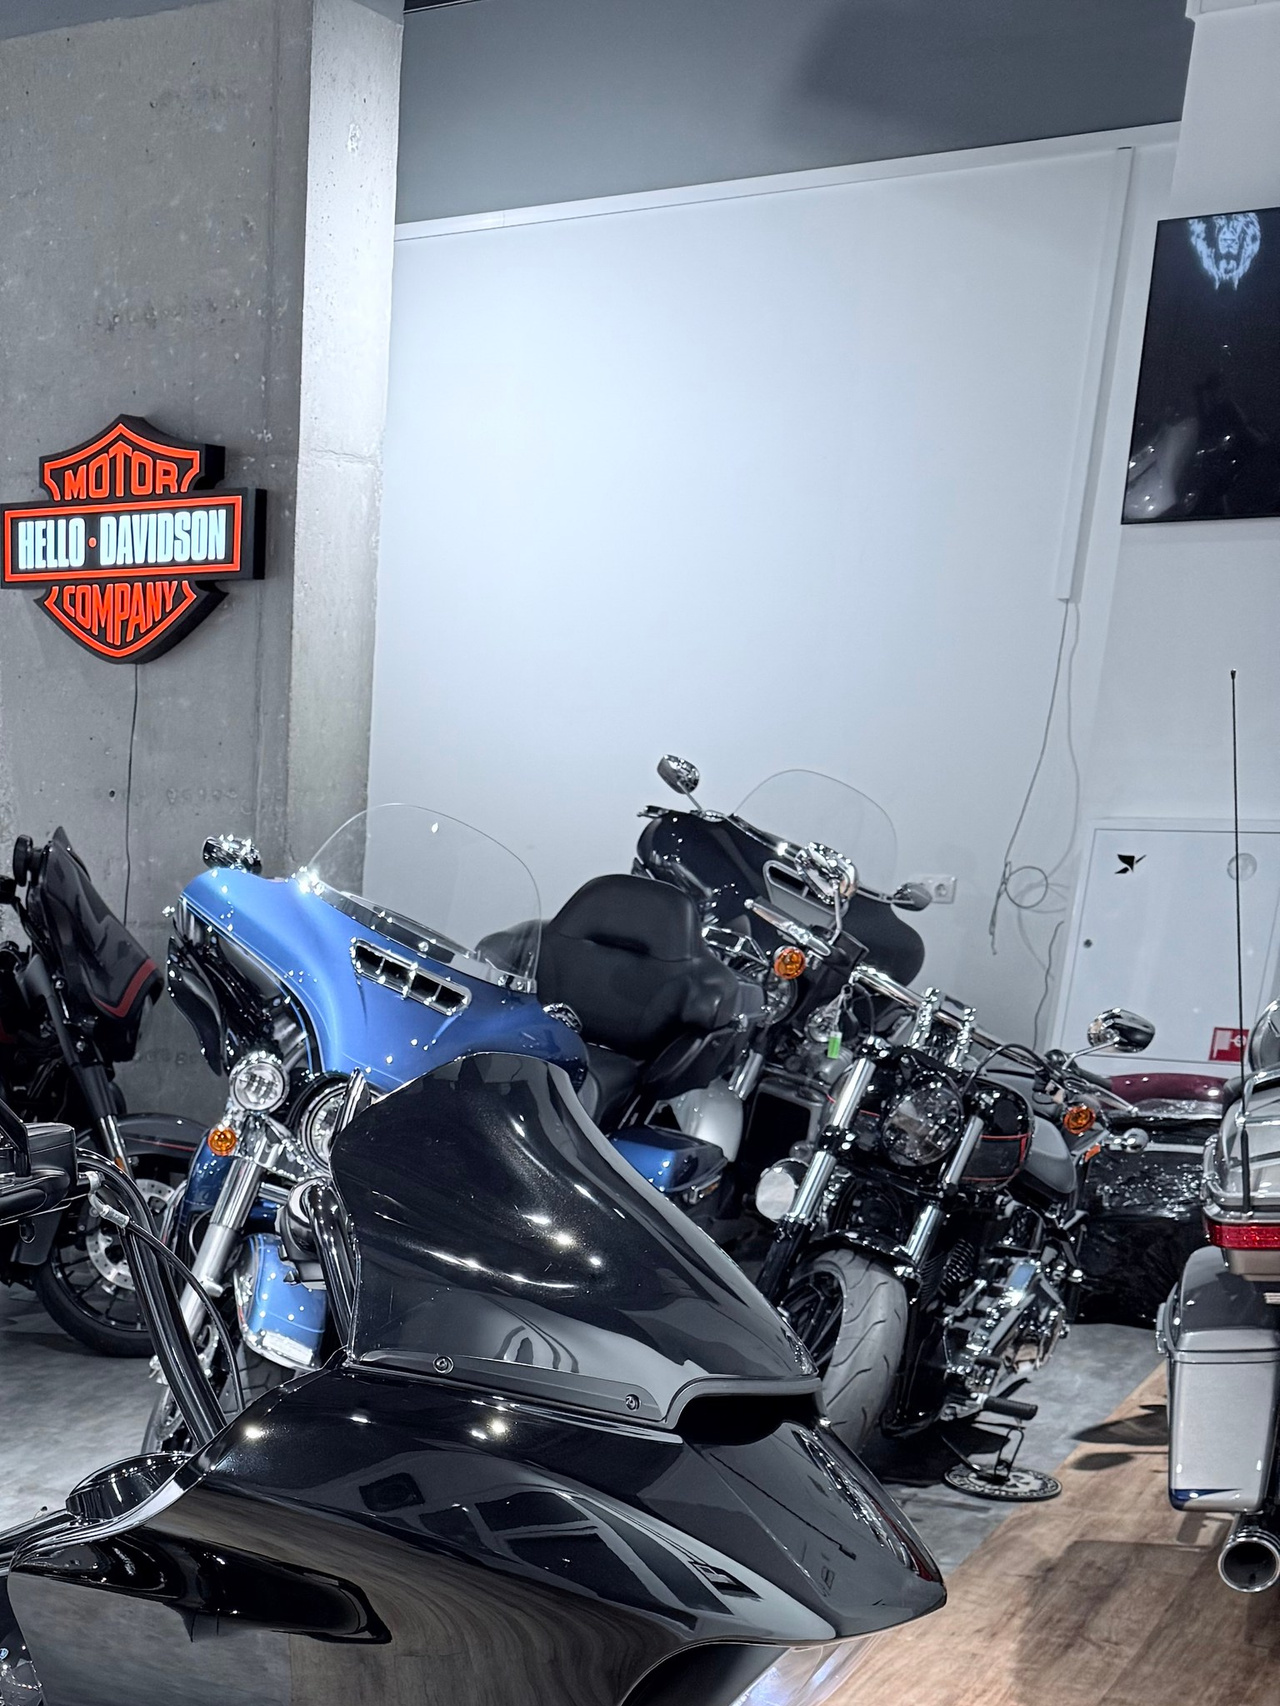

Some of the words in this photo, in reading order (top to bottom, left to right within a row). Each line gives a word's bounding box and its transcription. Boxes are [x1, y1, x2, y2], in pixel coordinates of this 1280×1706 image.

[64, 441, 178, 500] MOTOR
[18, 518, 85, 569] HELLO
[99, 509, 226, 566] DAVIDSON
[63, 580, 178, 646] COMPANY
